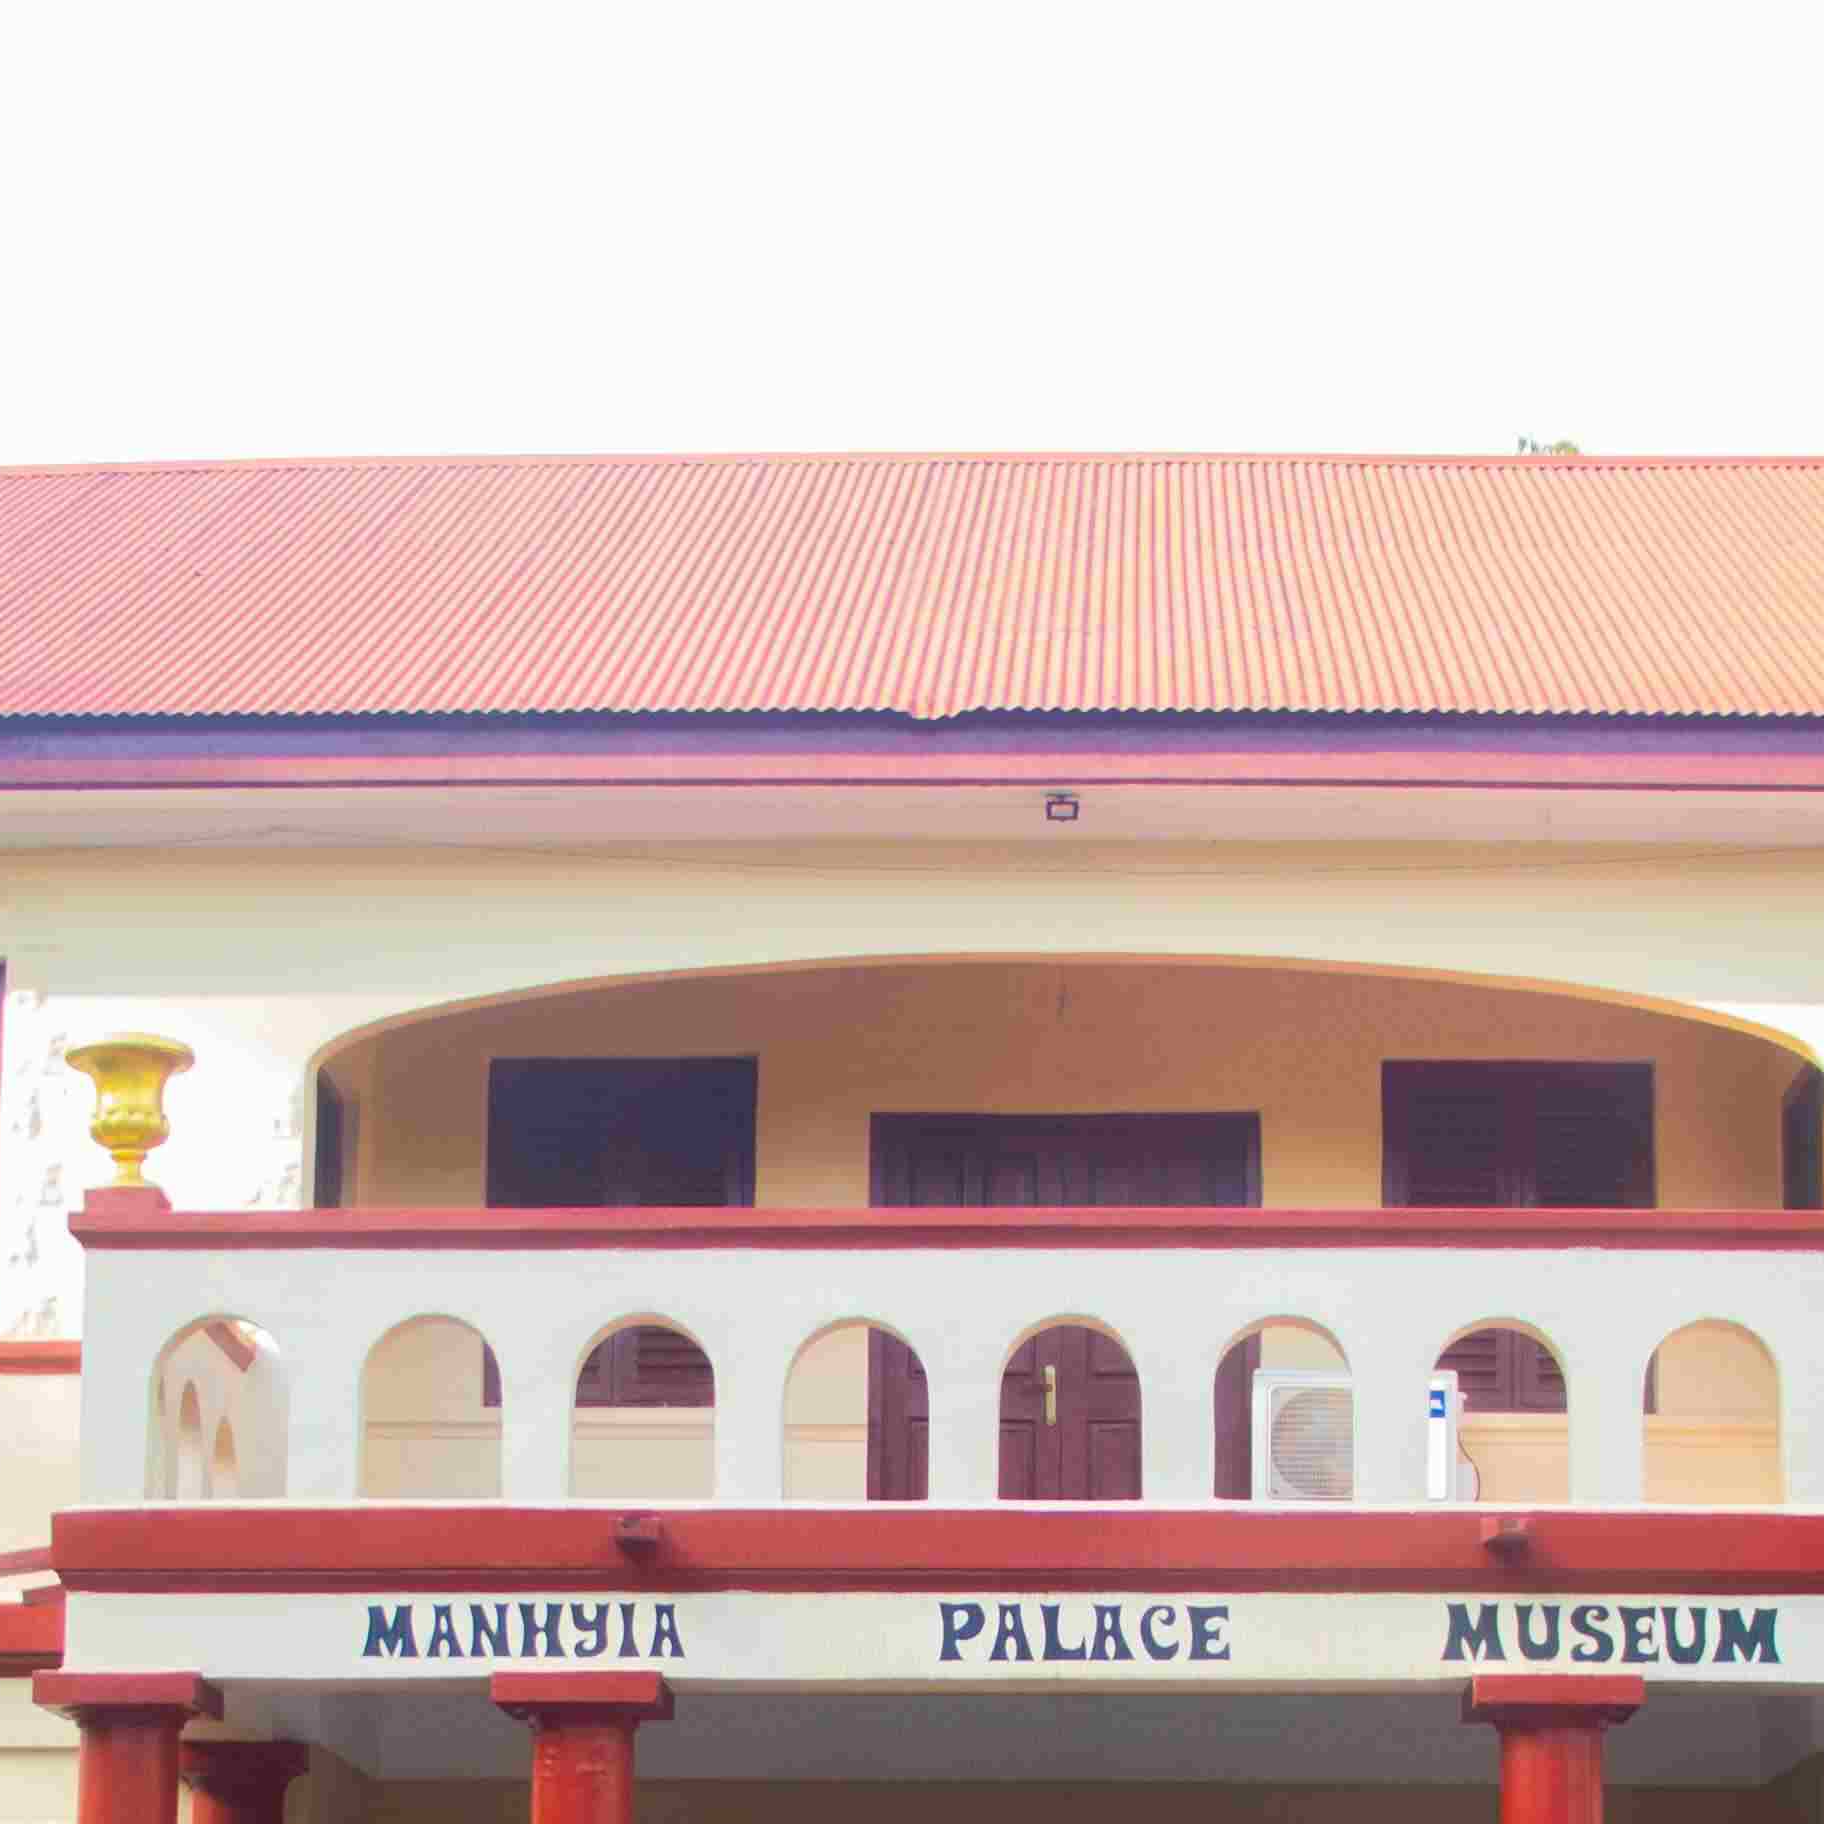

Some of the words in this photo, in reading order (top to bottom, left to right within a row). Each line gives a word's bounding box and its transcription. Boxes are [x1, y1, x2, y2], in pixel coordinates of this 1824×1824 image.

[362, 1602, 686, 1658] MANHYIA
[938, 1602, 1232, 1662] PALACE
[1440, 1602, 1782, 1665] MUSEUM
